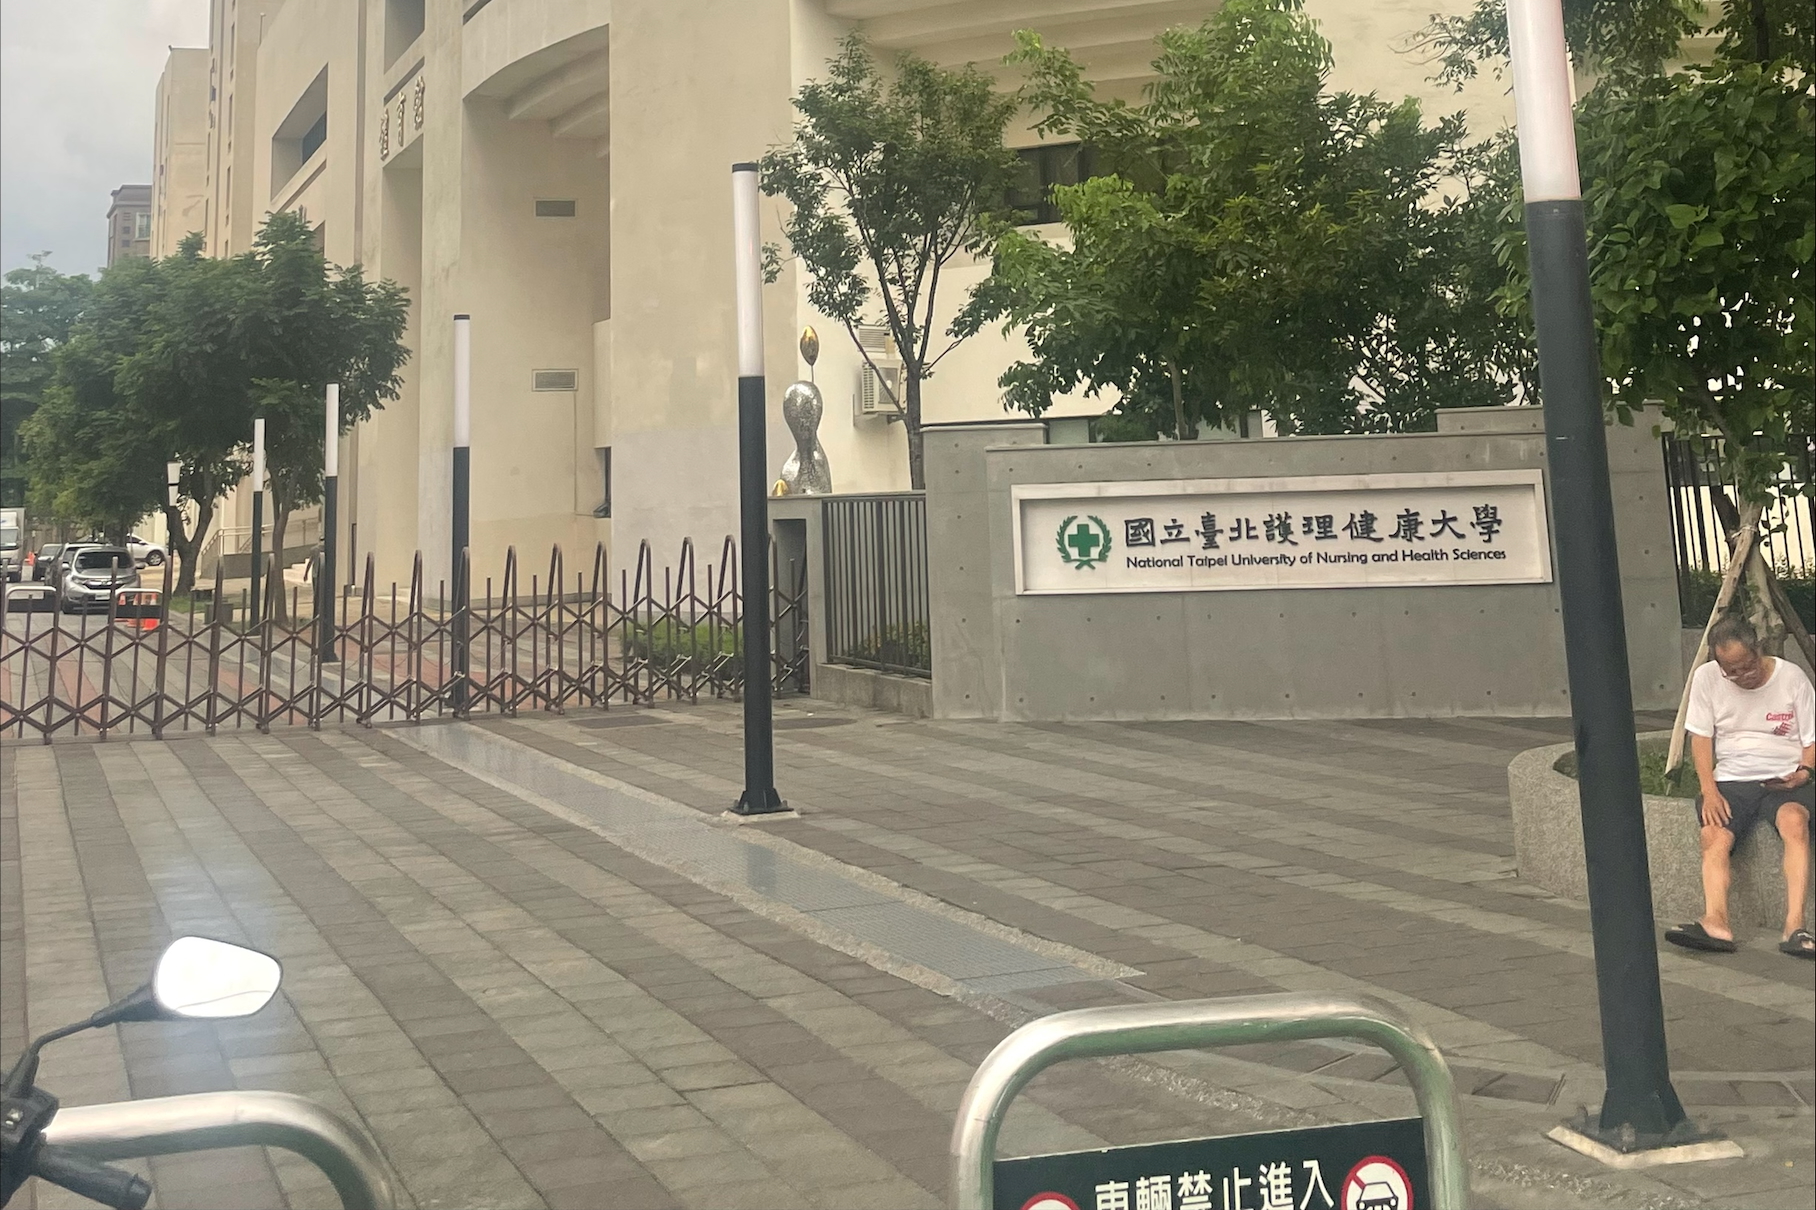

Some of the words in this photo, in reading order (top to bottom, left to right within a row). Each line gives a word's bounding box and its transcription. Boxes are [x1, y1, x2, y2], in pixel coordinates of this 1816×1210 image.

[1123, 503, 1503, 550] 國立臺北護理健康大學
[1126, 555, 1184, 569] National
[1187, 554, 1228, 569] Taipei
[1231, 553, 1296, 567] University
[1299, 552, 1312, 564] of
[1316, 551, 1368, 565] Nursing
[1371, 550, 1399, 563] and
[1402, 549, 1449, 562] Health
[1452, 548, 1506, 561] Sciences
[1095, 1159, 1334, 1210] 車輛禁止進入
